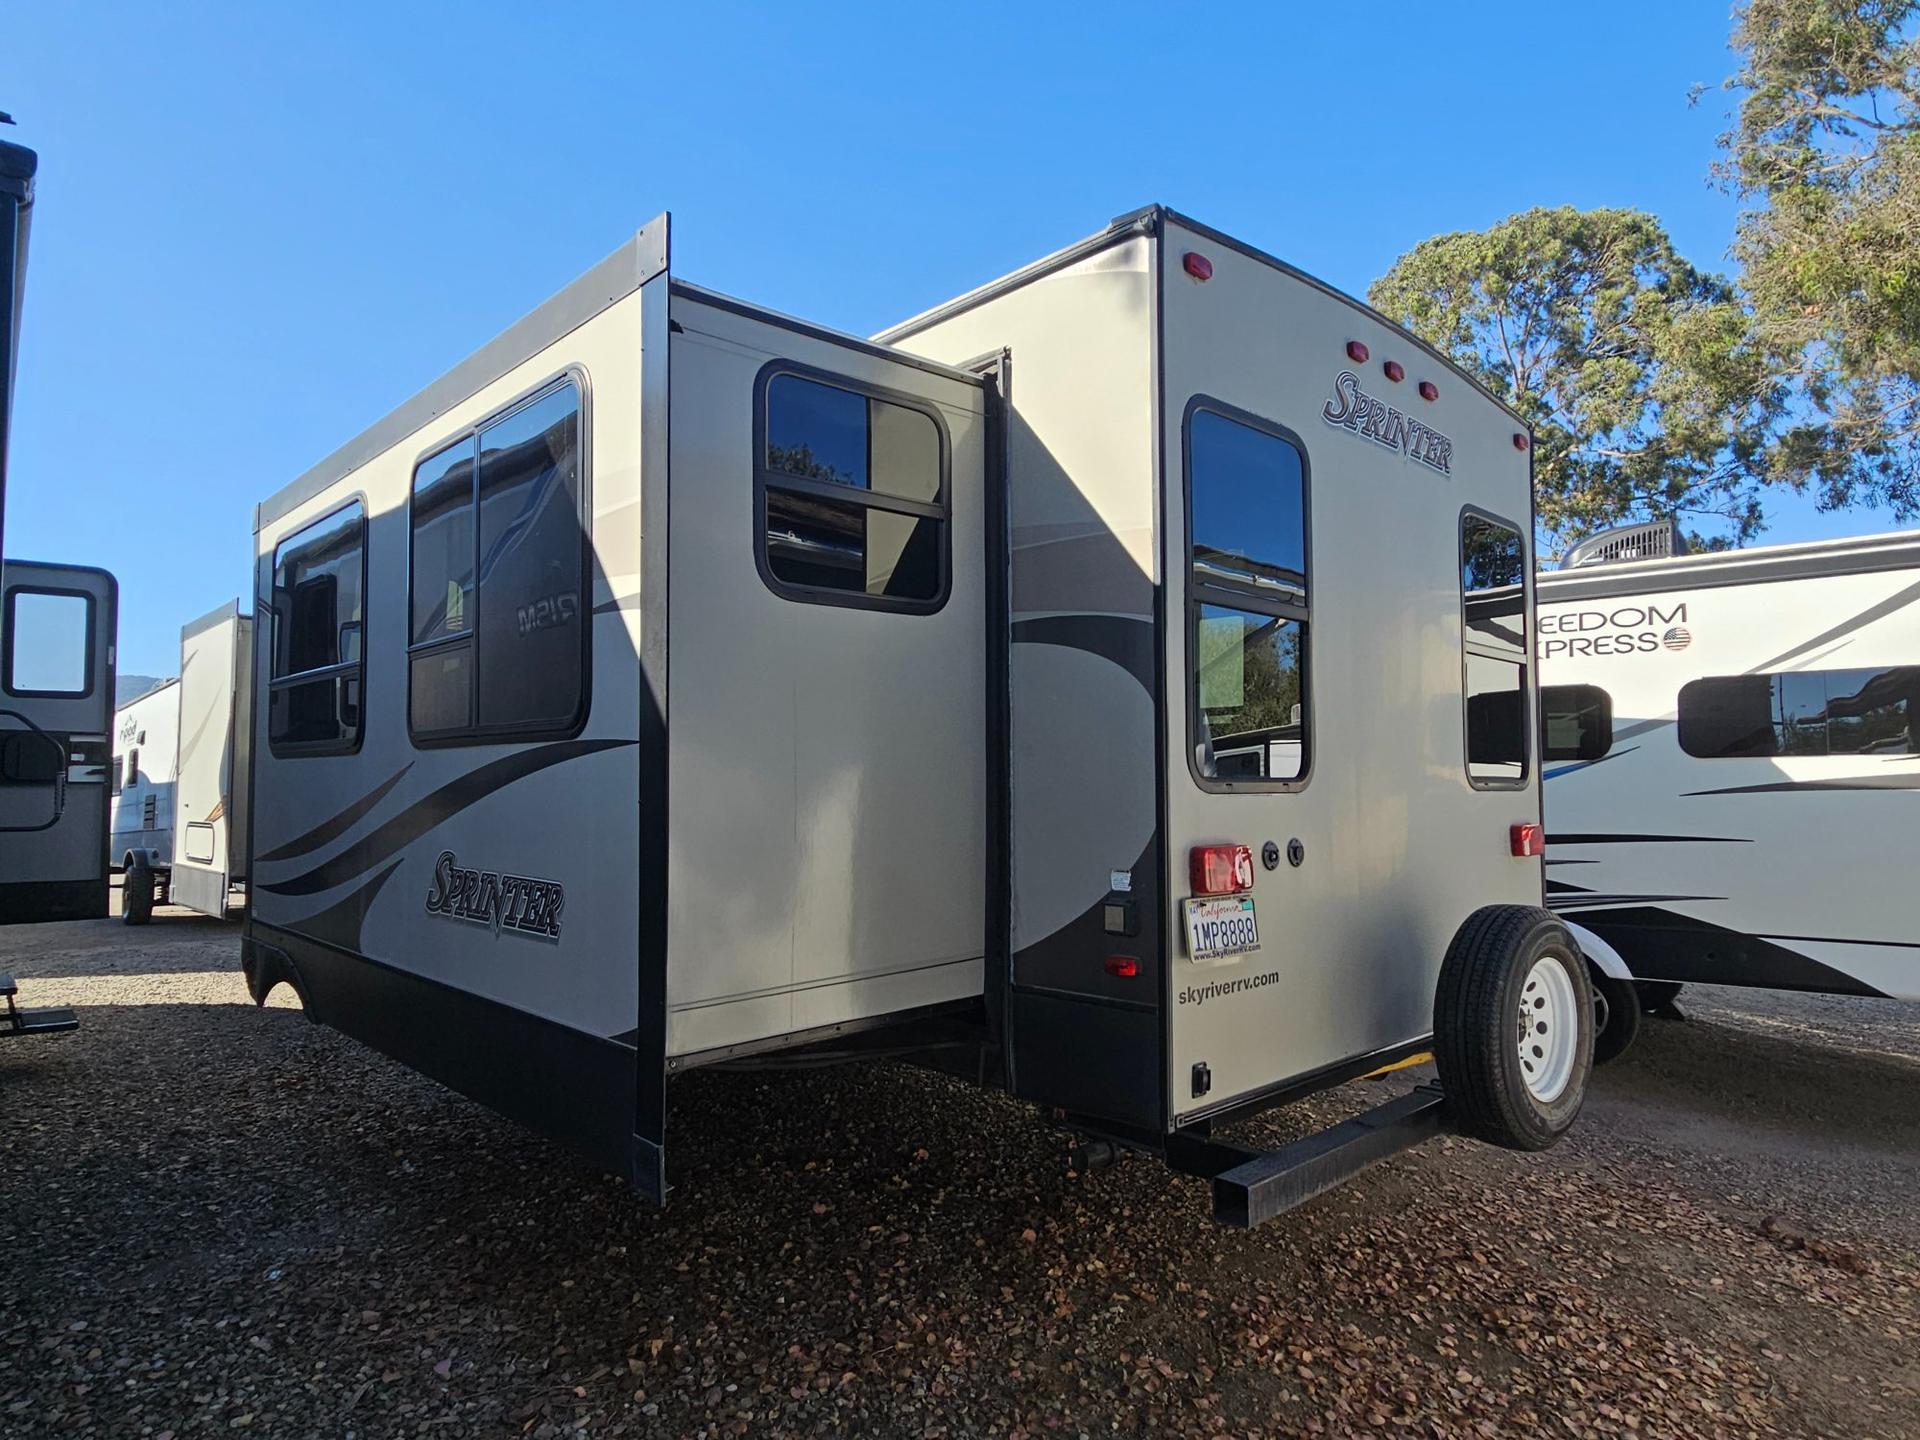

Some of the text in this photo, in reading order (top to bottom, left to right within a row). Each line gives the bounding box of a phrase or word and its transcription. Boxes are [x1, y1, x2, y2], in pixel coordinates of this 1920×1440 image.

[1321, 370, 1454, 476] SPRINTER
[1538, 632, 1660, 660] PRESS
[425, 850, 565, 939] SPRINTER
[1200, 902, 1243, 920] California
[1193, 917, 1255, 952] 1MP8888
[1178, 971, 1280, 1006] skyriverrv.com
